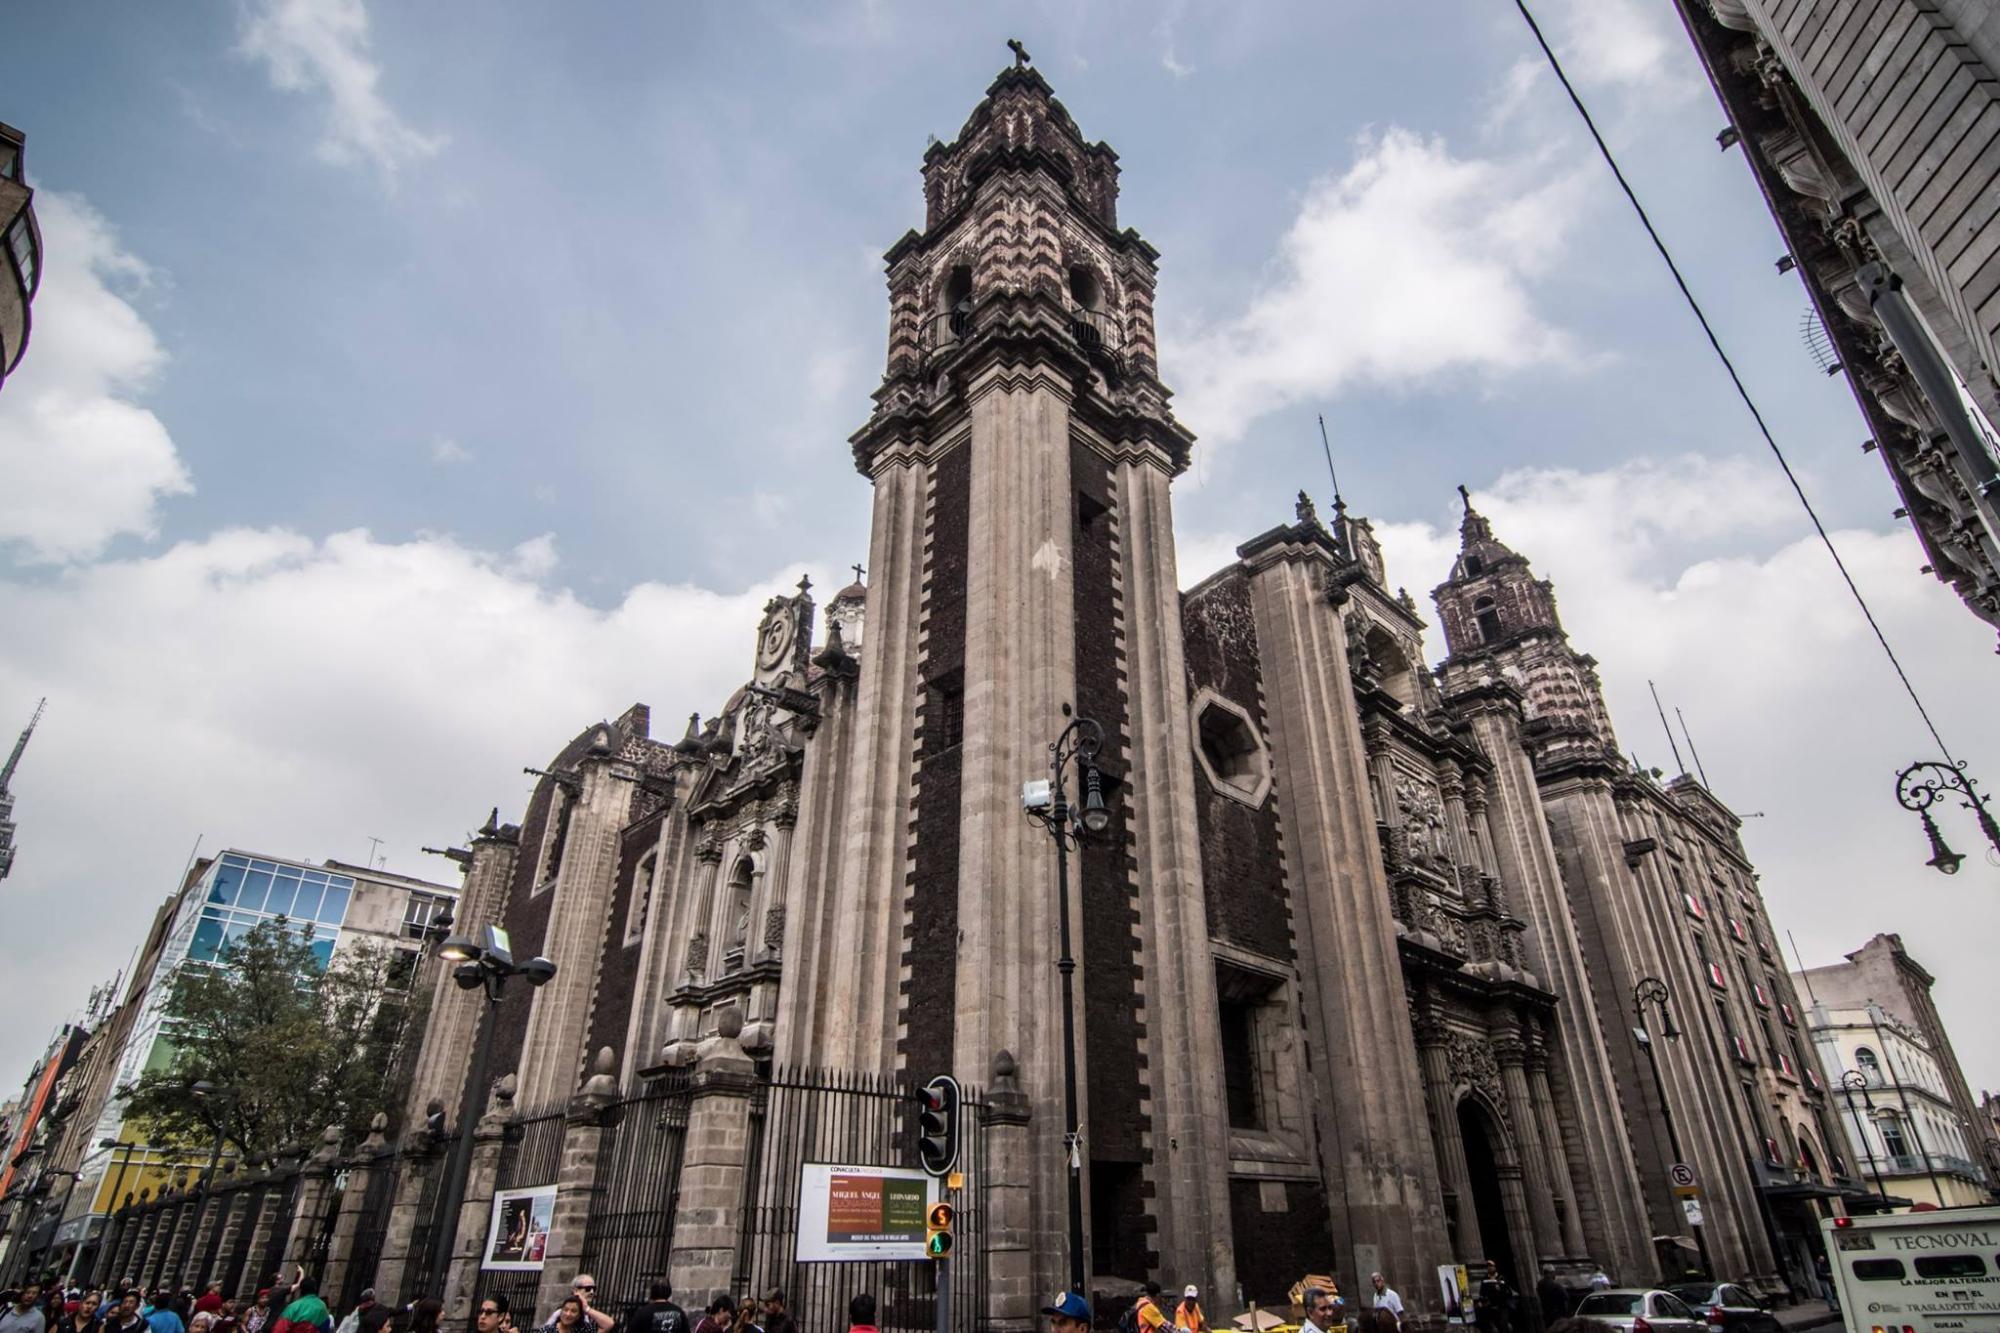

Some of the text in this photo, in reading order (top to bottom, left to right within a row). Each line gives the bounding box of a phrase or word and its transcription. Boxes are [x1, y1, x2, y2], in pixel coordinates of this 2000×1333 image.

[832, 1191, 859, 1199] MIGUEL
[889, 1193, 920, 1201] LEONARDO
[1889, 1232, 1998, 1250] TECNOVAL
[1914, 1278, 1946, 1286] MEJOR
[1906, 1303, 1960, 1312] TRASLADO
